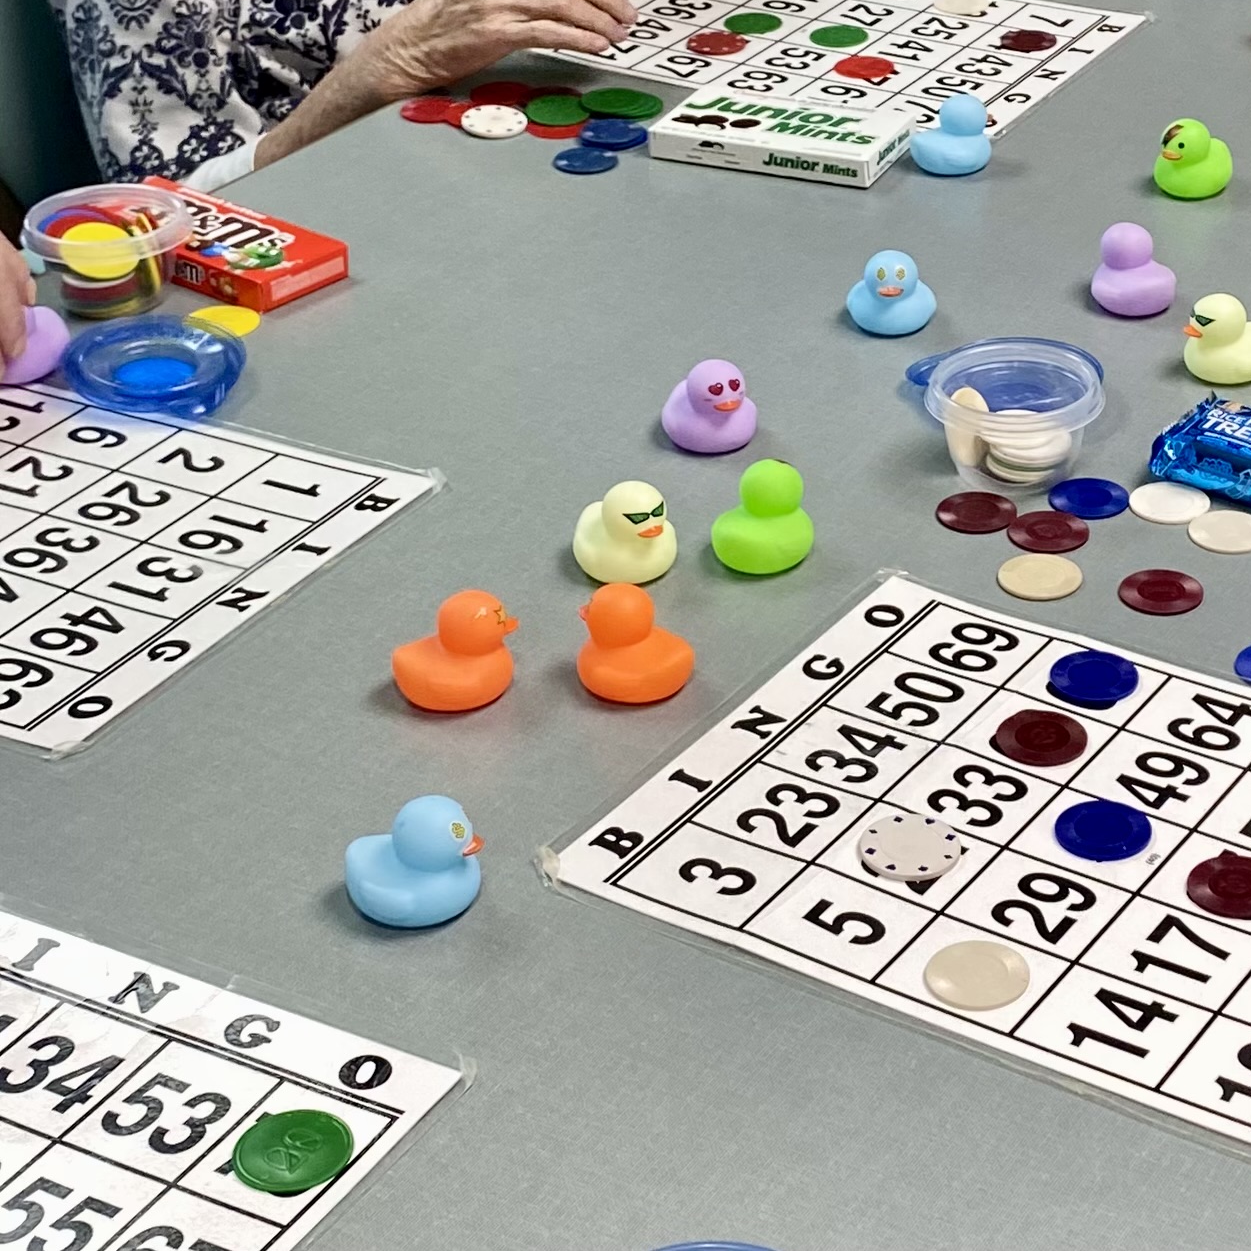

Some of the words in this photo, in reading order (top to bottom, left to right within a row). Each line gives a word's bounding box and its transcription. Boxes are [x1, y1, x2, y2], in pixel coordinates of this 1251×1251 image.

[840, 3, 894, 26] 27
[1029, 14, 1074, 28] 7
[911, 16, 970, 41] 25
[1097, 23, 1126, 34] B
[765, 47, 826, 71] 53
[878, 40, 934, 61] 41
[1068, 47, 1095, 55] I
[655, 55, 712, 79] 67
[955, 53, 1014, 79] 43
[1034, 68, 1067, 81] N
[727, 70, 788, 94] 63
[1003, 92, 1031, 105] G
[685, 97, 863, 128] Junior
[765, 121, 876, 145] Mints
[762, 152, 819, 172] Junior
[822, 163, 859, 179] Mints
[1206, 409, 1247, 425] RICE
[67, 426, 128, 449] 6
[157, 447, 225, 473] 2
[262, 479, 321, 497] 1
[78, 480, 171, 527] 26
[353, 493, 400, 513] B
[178, 514, 269, 555] 16
[3, 527, 100, 575] 36
[291, 542, 332, 557] I
[107, 556, 204, 603] 31
[216, 587, 270, 614] N
[30, 605, 125, 657] 46
[148, 640, 191, 663] G
[67, 695, 113, 720] O
[588, 826, 645, 860] B
[669, 768, 713, 793] I
[731, 705, 788, 740] N
[802, 653, 846, 682] G
[864, 604, 905, 628] O
[678, 857, 758, 897] 3
[736, 783, 841, 848] 23
[805, 723, 908, 785] 34
[866, 671, 965, 729] 50
[928, 621, 1020, 673] 69
[802, 898, 886, 945] 5
[927, 764, 1029, 829] 33
[991, 871, 1098, 945] 29
[1115, 751, 1210, 810] 49
[1066, 987, 1180, 1059] 14
[1131, 914, 1232, 984] 17
[11, 938, 60, 971] I
[108, 971, 180, 1013] N
[224, 1014, 280, 1048] G
[338, 1054, 392, 1090] O
[0, 1035, 125, 1115] 34
[101, 1072, 232, 1155] 53
